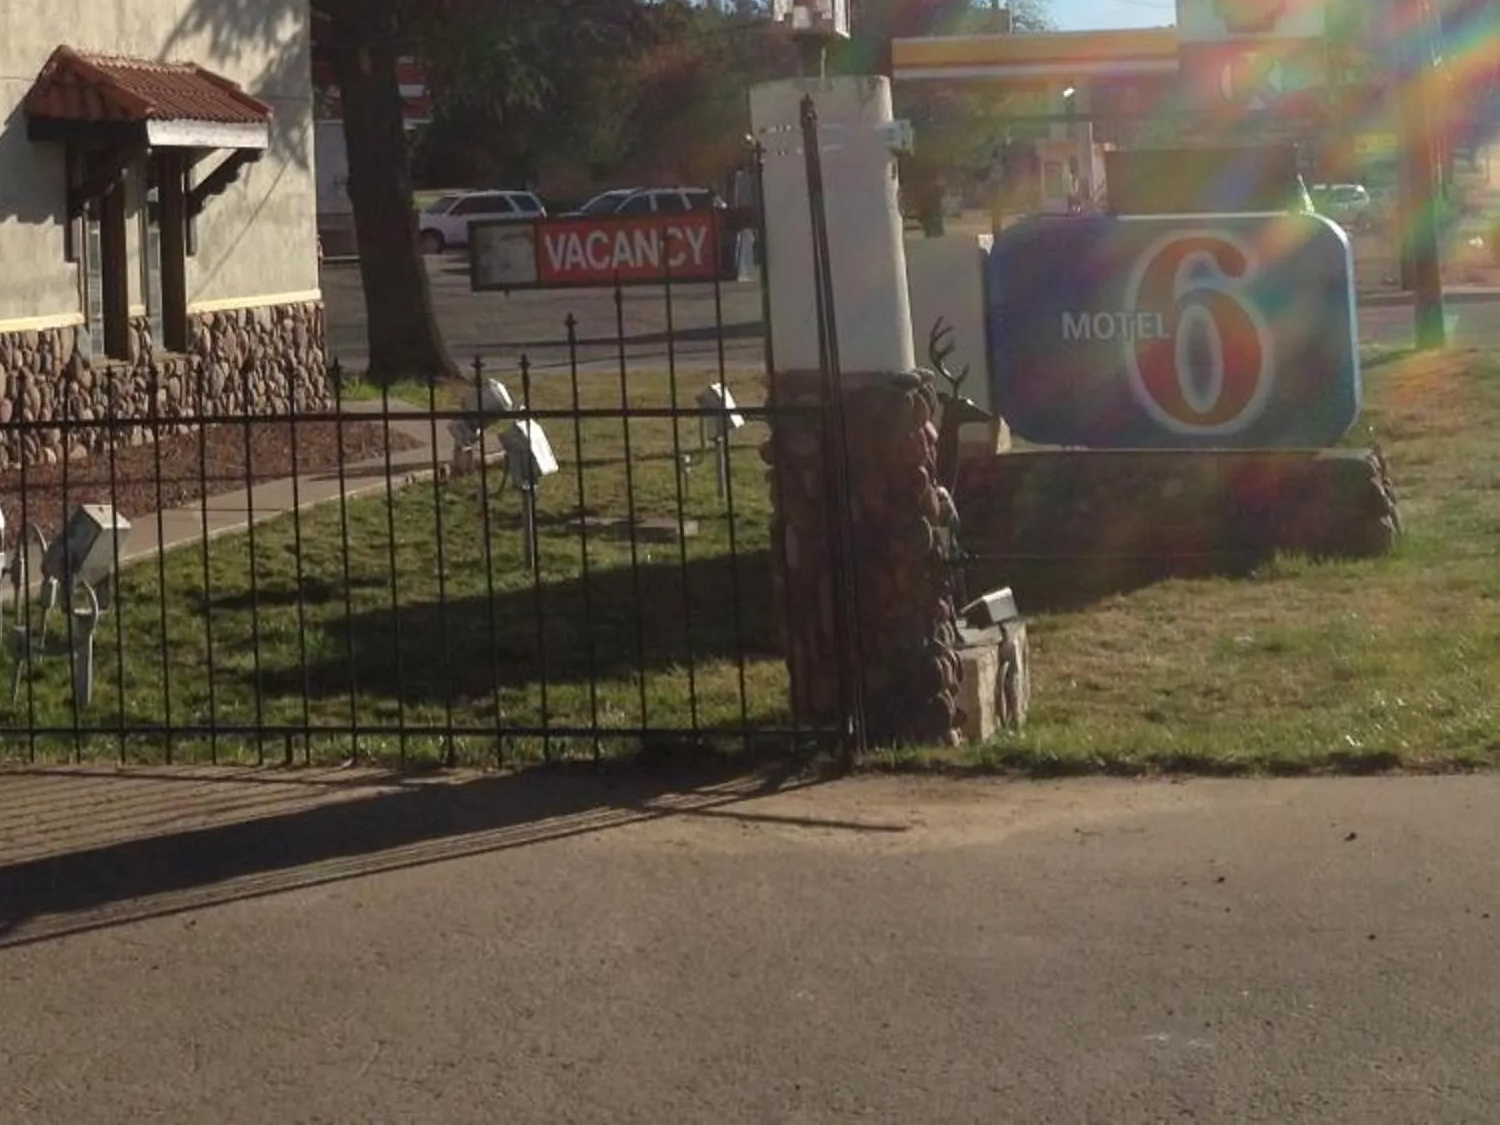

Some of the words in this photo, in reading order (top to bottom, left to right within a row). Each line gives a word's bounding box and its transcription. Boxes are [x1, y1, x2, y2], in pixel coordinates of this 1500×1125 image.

[544, 225, 709, 272] VACANCY
[1060, 311, 1172, 340] MOTEL
[1128, 231, 1268, 432] 6
